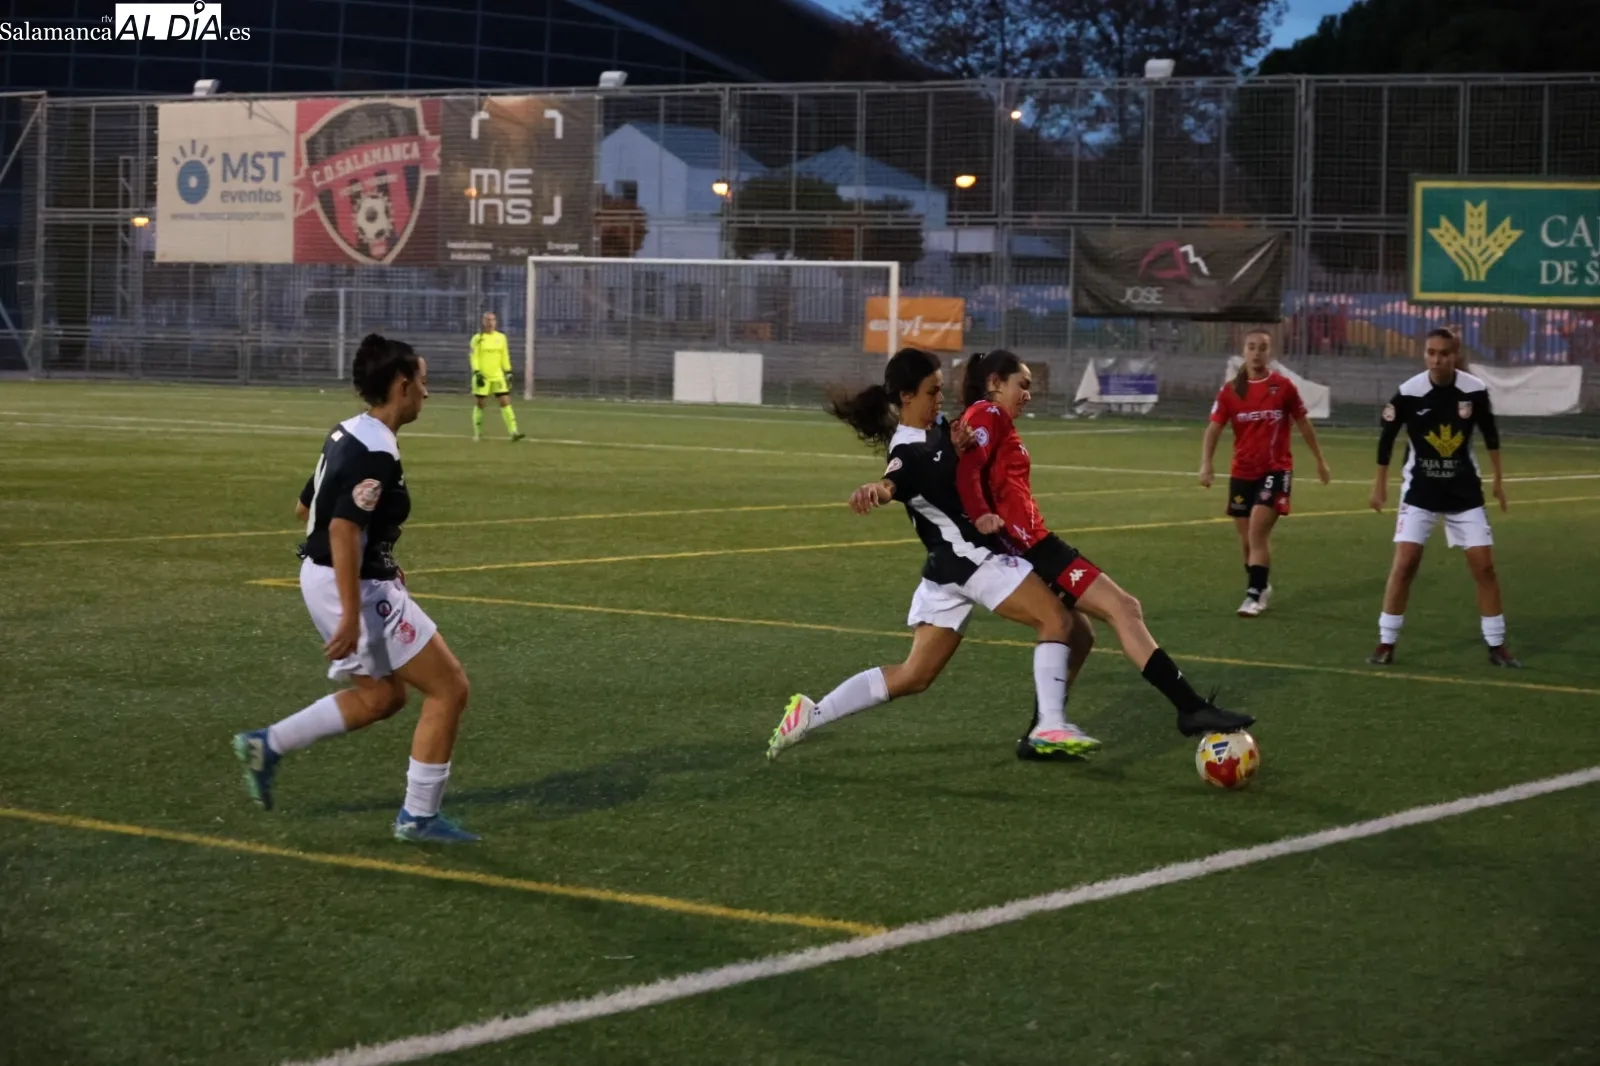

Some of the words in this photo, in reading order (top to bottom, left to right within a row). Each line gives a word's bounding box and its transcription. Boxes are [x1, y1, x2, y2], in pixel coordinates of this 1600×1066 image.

[221, 151, 286, 183] MST
[220, 186, 282, 204] eventos
[1540, 260, 1578, 286] DE
[1120, 286, 1164, 304] JOSE
[1264, 475, 1275, 489] 5
